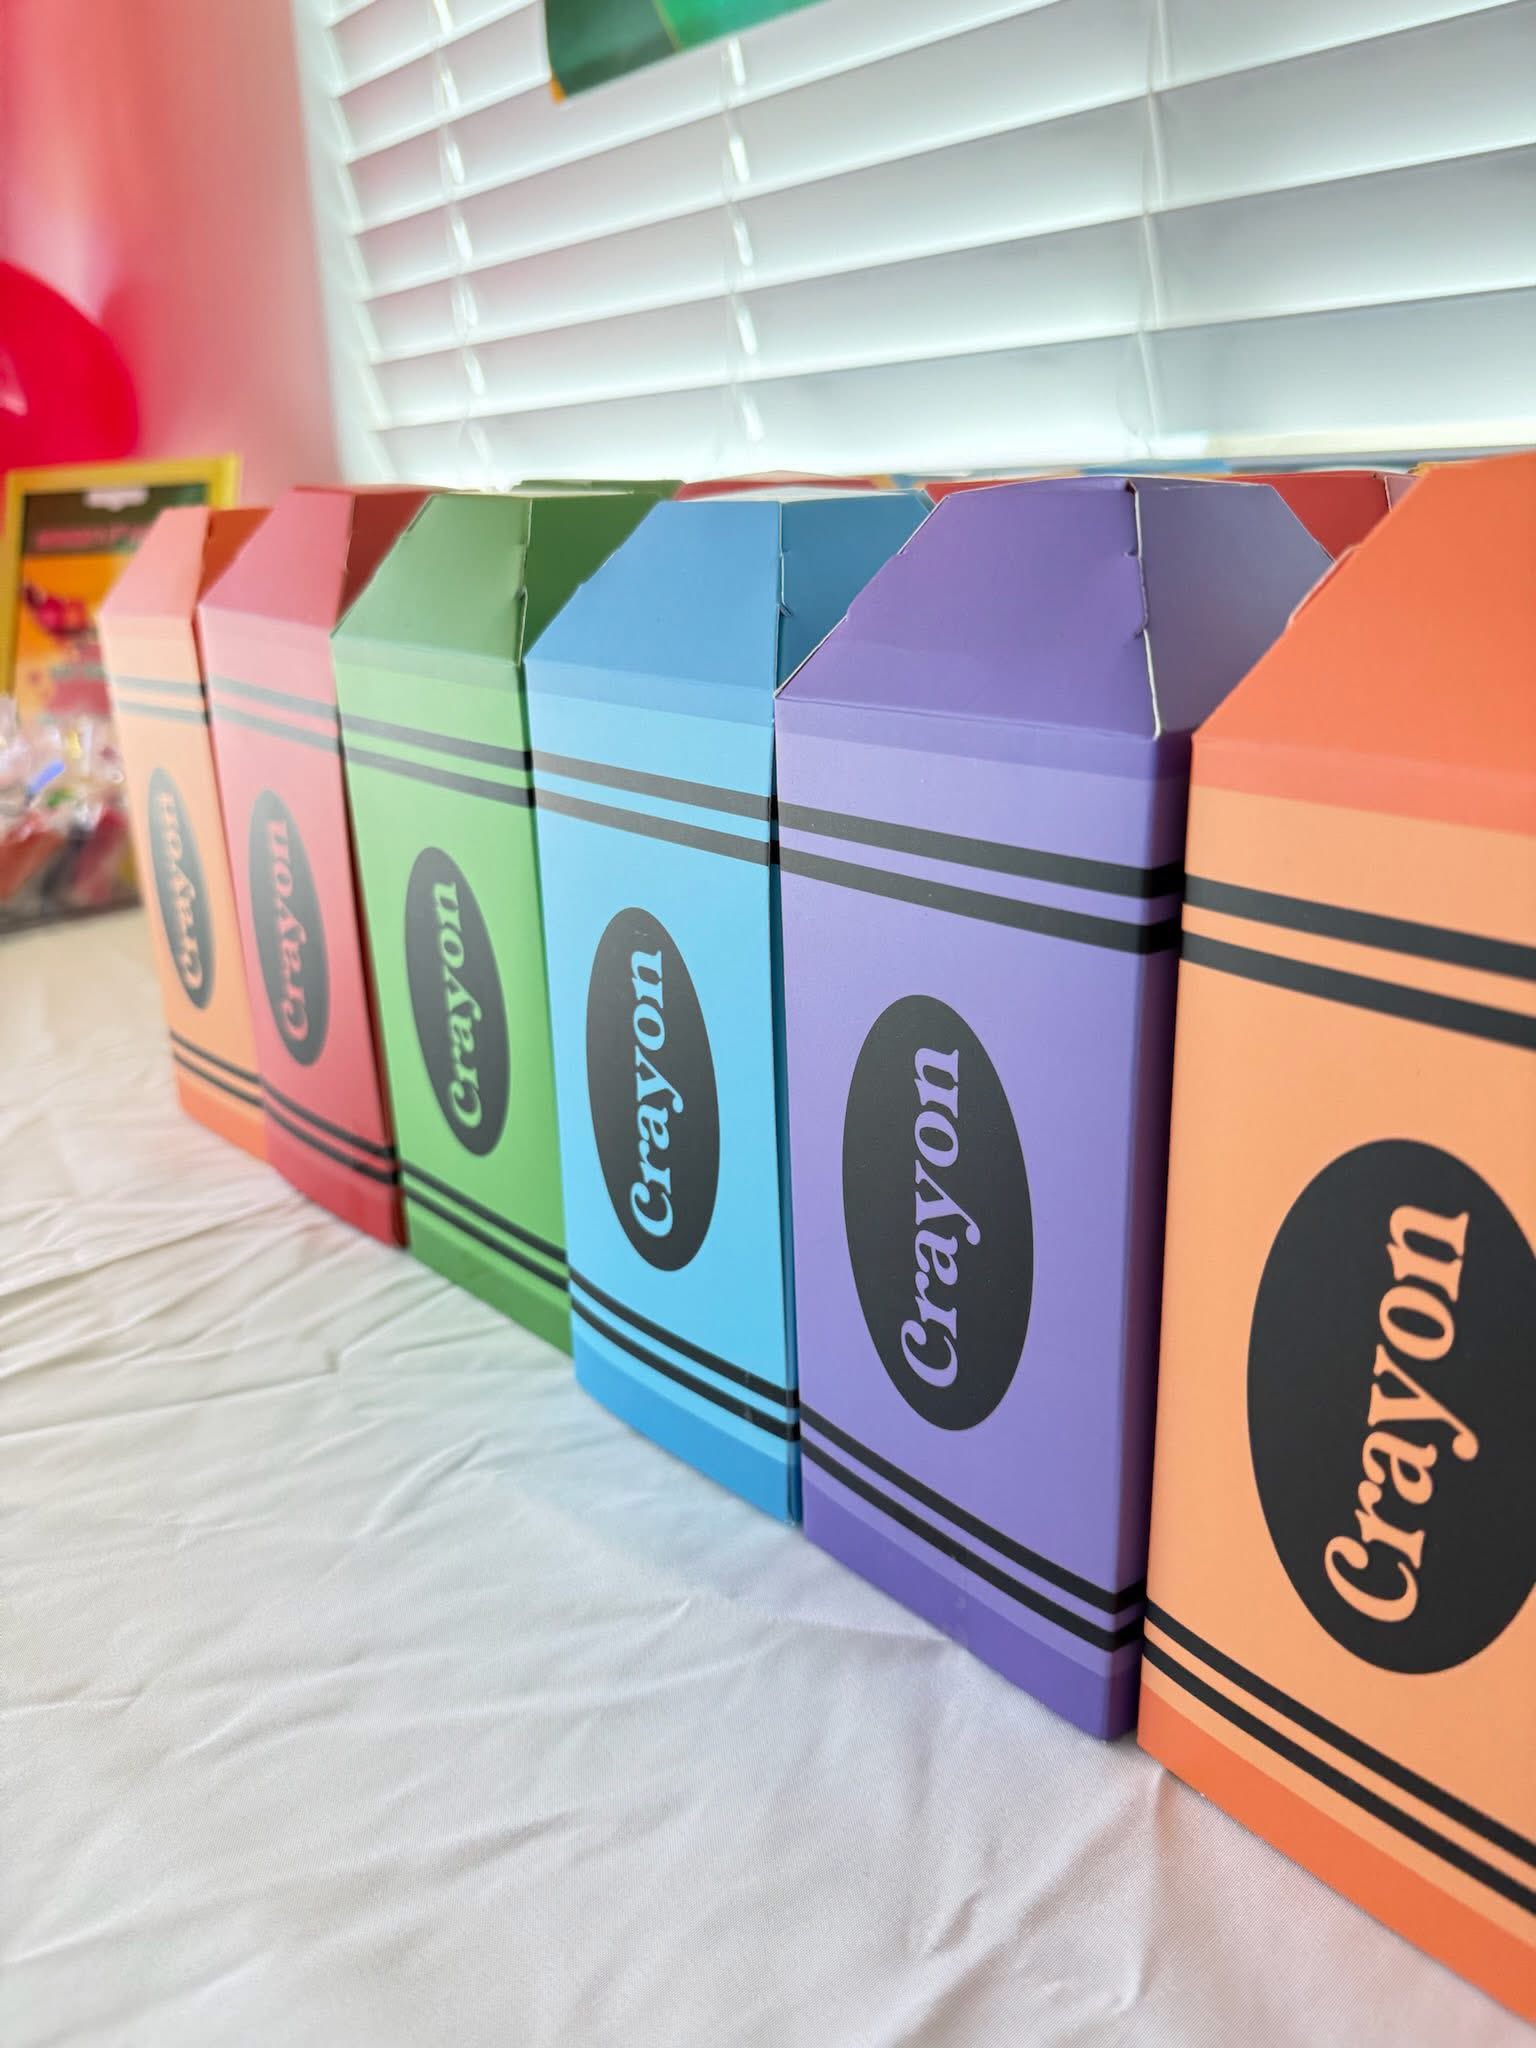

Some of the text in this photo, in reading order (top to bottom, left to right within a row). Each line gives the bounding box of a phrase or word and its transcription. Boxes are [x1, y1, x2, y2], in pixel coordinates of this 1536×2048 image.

[158, 791, 204, 990] Crayon
[266, 819, 309, 1041] Crayon
[432, 881, 483, 1129] Crayon
[631, 949, 685, 1238] Crayon
[900, 1047, 982, 1388] Crayon
[1324, 1204, 1480, 1623] Crayon
